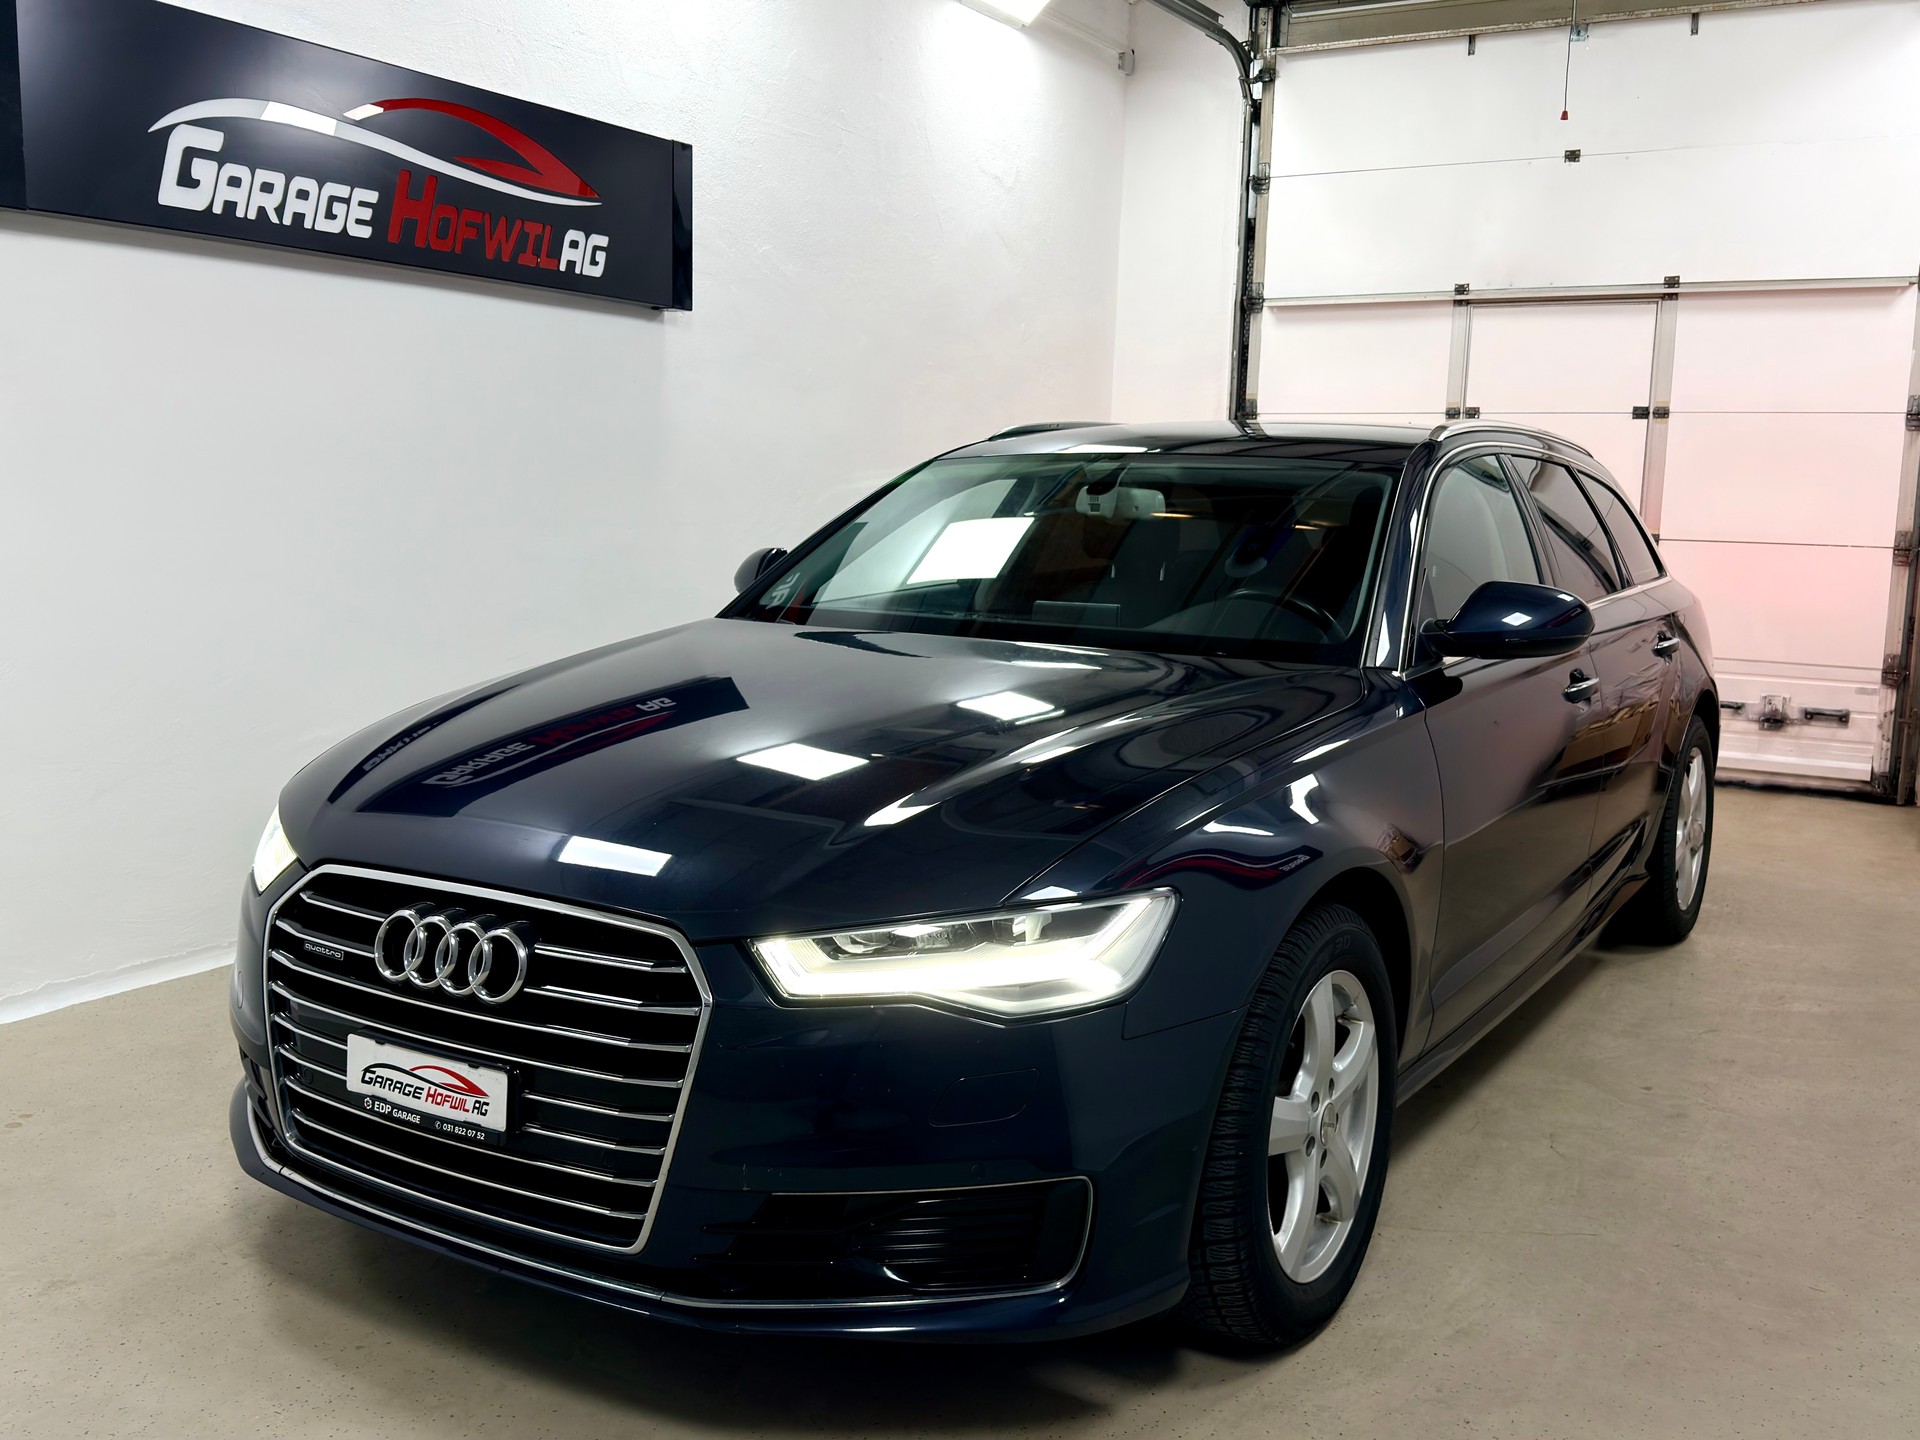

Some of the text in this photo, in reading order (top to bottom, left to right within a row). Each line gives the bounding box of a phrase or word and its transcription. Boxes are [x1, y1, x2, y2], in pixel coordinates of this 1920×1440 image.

[157, 123, 380, 239] GARAGE
[305, 943, 341, 958] quattro
[361, 1069, 490, 1116] GARAGE HOFWIL AG
[374, 1101, 421, 1124] EDP GARAGE
[442, 1123, 485, 1140] 031 822 07 52
